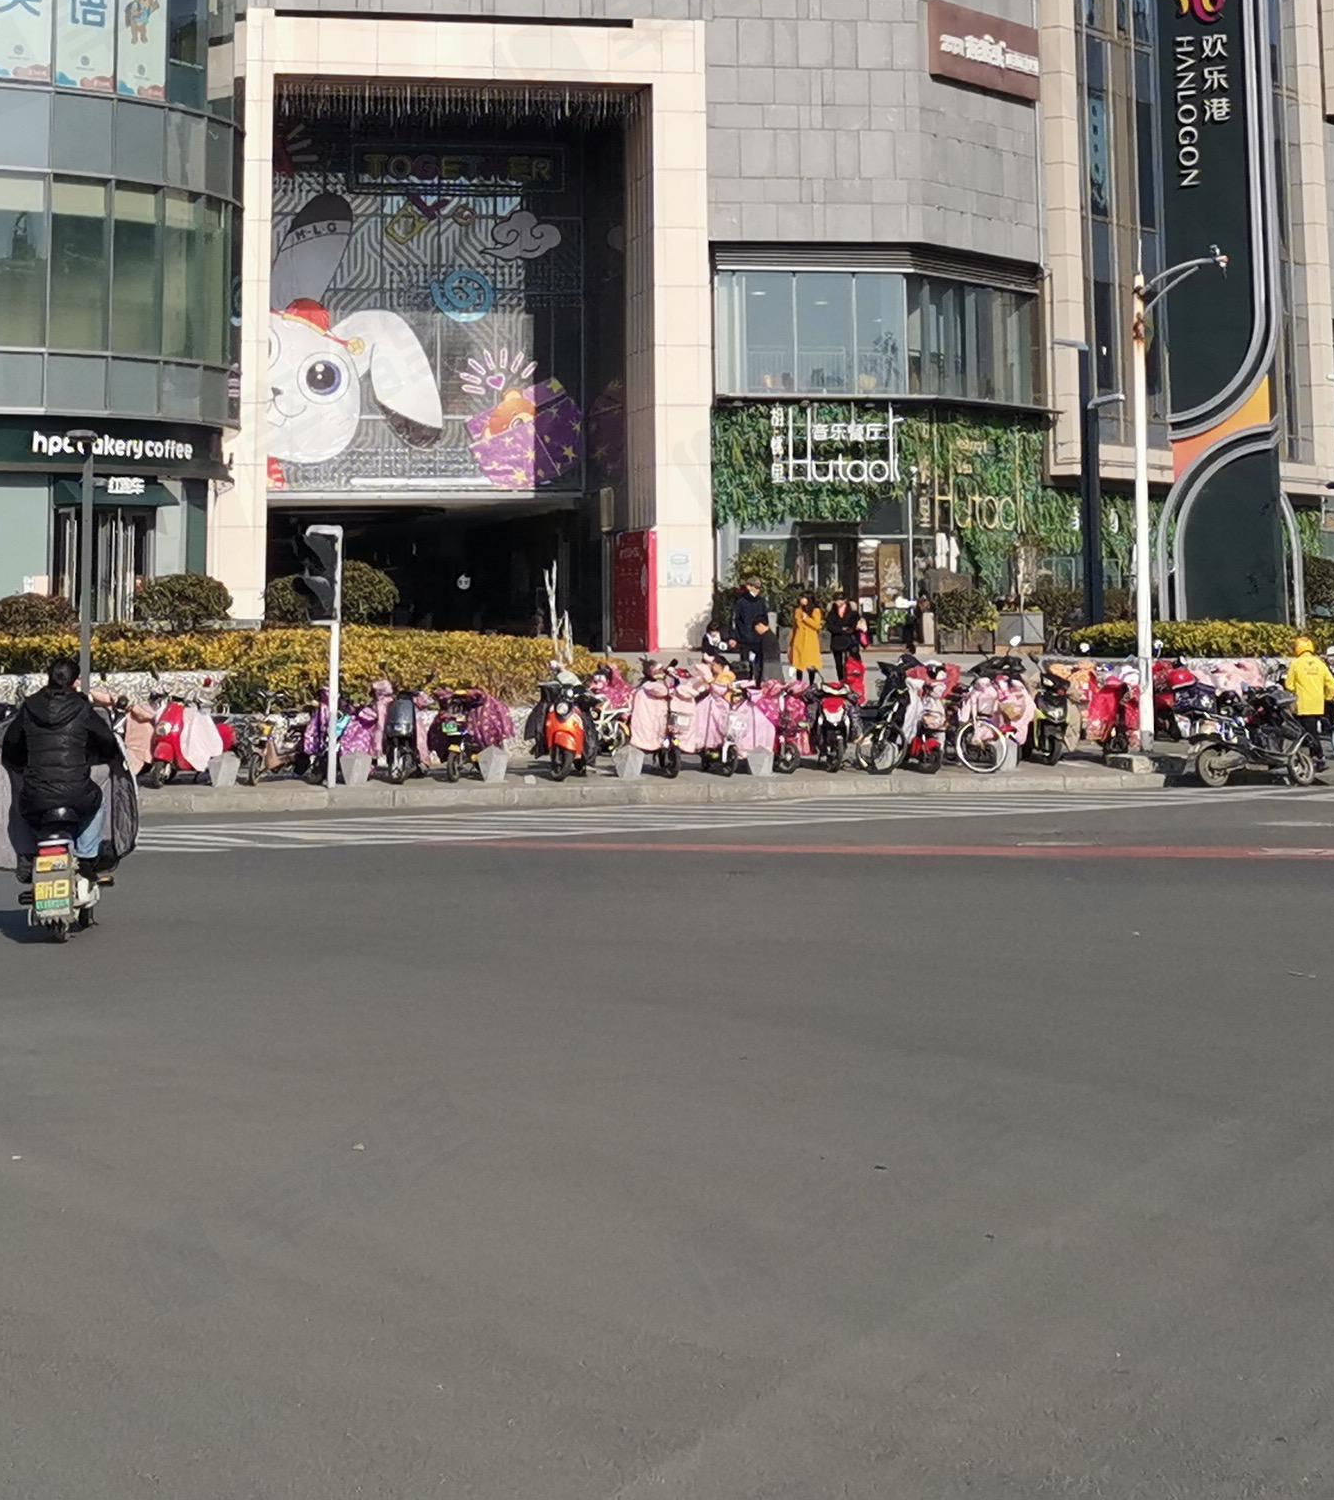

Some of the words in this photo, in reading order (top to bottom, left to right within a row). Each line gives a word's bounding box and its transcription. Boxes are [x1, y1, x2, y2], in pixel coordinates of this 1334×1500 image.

[1175, 36, 1201, 190] HANLOGON
[1201, 33, 1231, 123] 欢乐港
[365, 154, 552, 181] TOGETER
